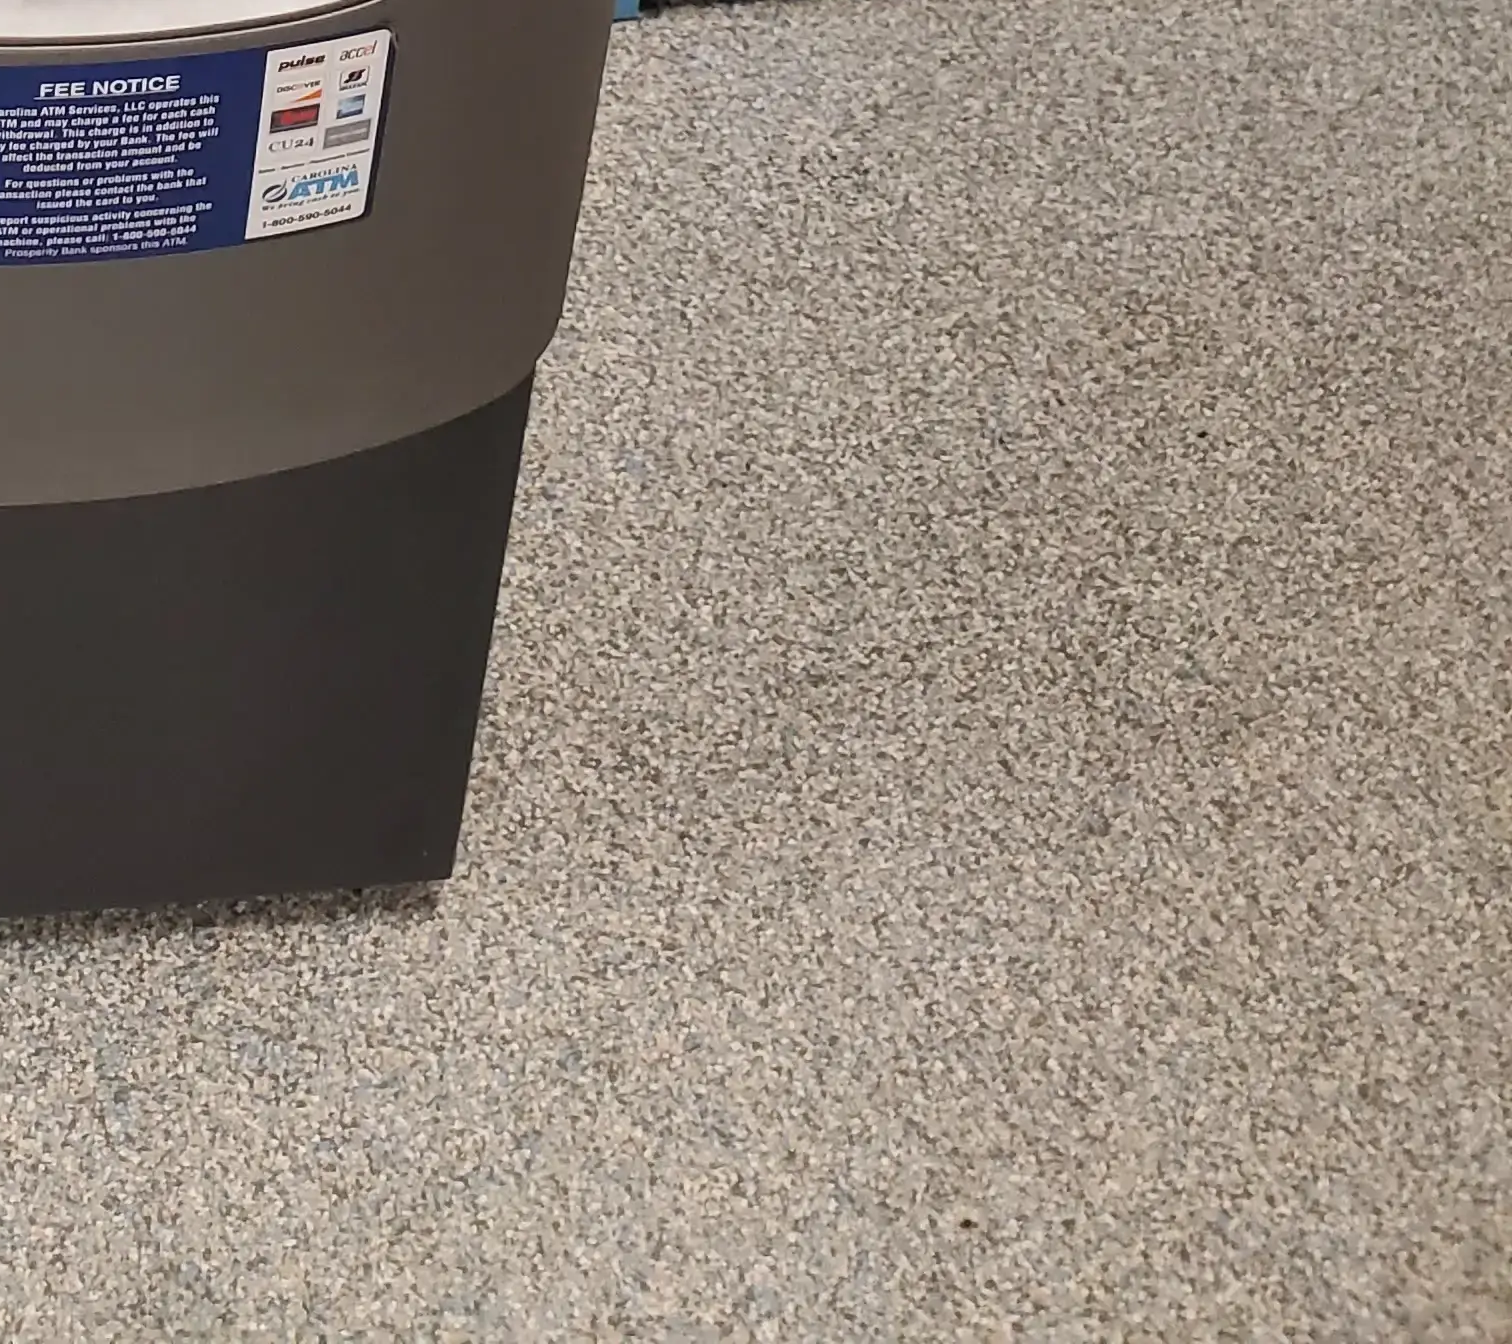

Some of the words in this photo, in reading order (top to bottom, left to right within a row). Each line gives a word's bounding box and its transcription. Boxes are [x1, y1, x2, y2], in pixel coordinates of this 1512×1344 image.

[339, 39, 377, 61] accel
[277, 55, 326, 72] pulse
[40, 82, 86, 97] FEE
[92, 75, 181, 95] NOTICE
[40, 106, 66, 116] ATM
[124, 101, 146, 112] LLC
[148, 98, 197, 111] operates
[199, 94, 220, 105] this
[20, 119, 41, 128] and
[44, 119, 68, 130] may
[71, 116, 109, 127] charge
[112, 116, 119, 124] a
[122, 113, 140, 123] fee
[142, 112, 158, 122] for
[160, 110, 188, 120] each
[189, 106, 216, 117] cash
[62, 128, 85, 138] This
[88, 126, 126, 138] charge
[129, 124, 139, 134] is
[142, 123, 153, 133] in
[155, 119, 201, 131] addition
[203, 117, 214, 127] to
[8, 142, 27, 151] fee
[29, 140, 74, 151] charged
[77, 139, 91, 150] by
[93, 138, 118, 149] your
[156, 133, 176, 143] The
[178, 131, 196, 141] fee
[198, 127, 219, 138] will
[268, 137, 314, 152] CU24
[1, 153, 33, 162] affect
[35, 152, 54, 161] the
[56, 149, 118, 161] transaction
[121, 144, 162, 157] amount
[165, 142, 185, 153] and
[188, 141, 202, 151] be
[22, 162, 74, 173] deducted
[76, 161, 102, 171] from
[105, 159, 130, 170] your
[291, 164, 357, 183] CAROLINA
[5, 179, 24, 189] For
[26, 178, 80, 189] questions
[82, 177, 94, 185] or
[96, 173, 148, 186] problems
[151, 170, 174, 180] with
[177, 168, 195, 178] the
[54, 188, 92, 199] please
[94, 184, 134, 196] contact
[136, 183, 154, 192] the
[156, 179, 183, 190] bank
[185, 176, 207, 187] that
[288, 170, 359, 200] ATM
[36, 199, 73, 209] issued
[75, 198, 93, 208] the
[95, 195, 120, 206] card
[122, 195, 133, 204] to
[31, 214, 89, 225] suspicious
[92, 211, 131, 222] activity
[134, 204, 193, 218] concerning
[195, 201, 213, 211] the
[261, 204, 352, 228] 1-800-590-5044
[21, 227, 33, 235] or
[35, 223, 98, 236] operational
[100, 219, 151, 232] problems
[154, 216, 177, 226] with
[4, 247, 59, 258] Prosperity
[61, 246, 87, 255] Bank
[89, 243, 139, 254] sponsors
[46, 236, 83, 247] please
